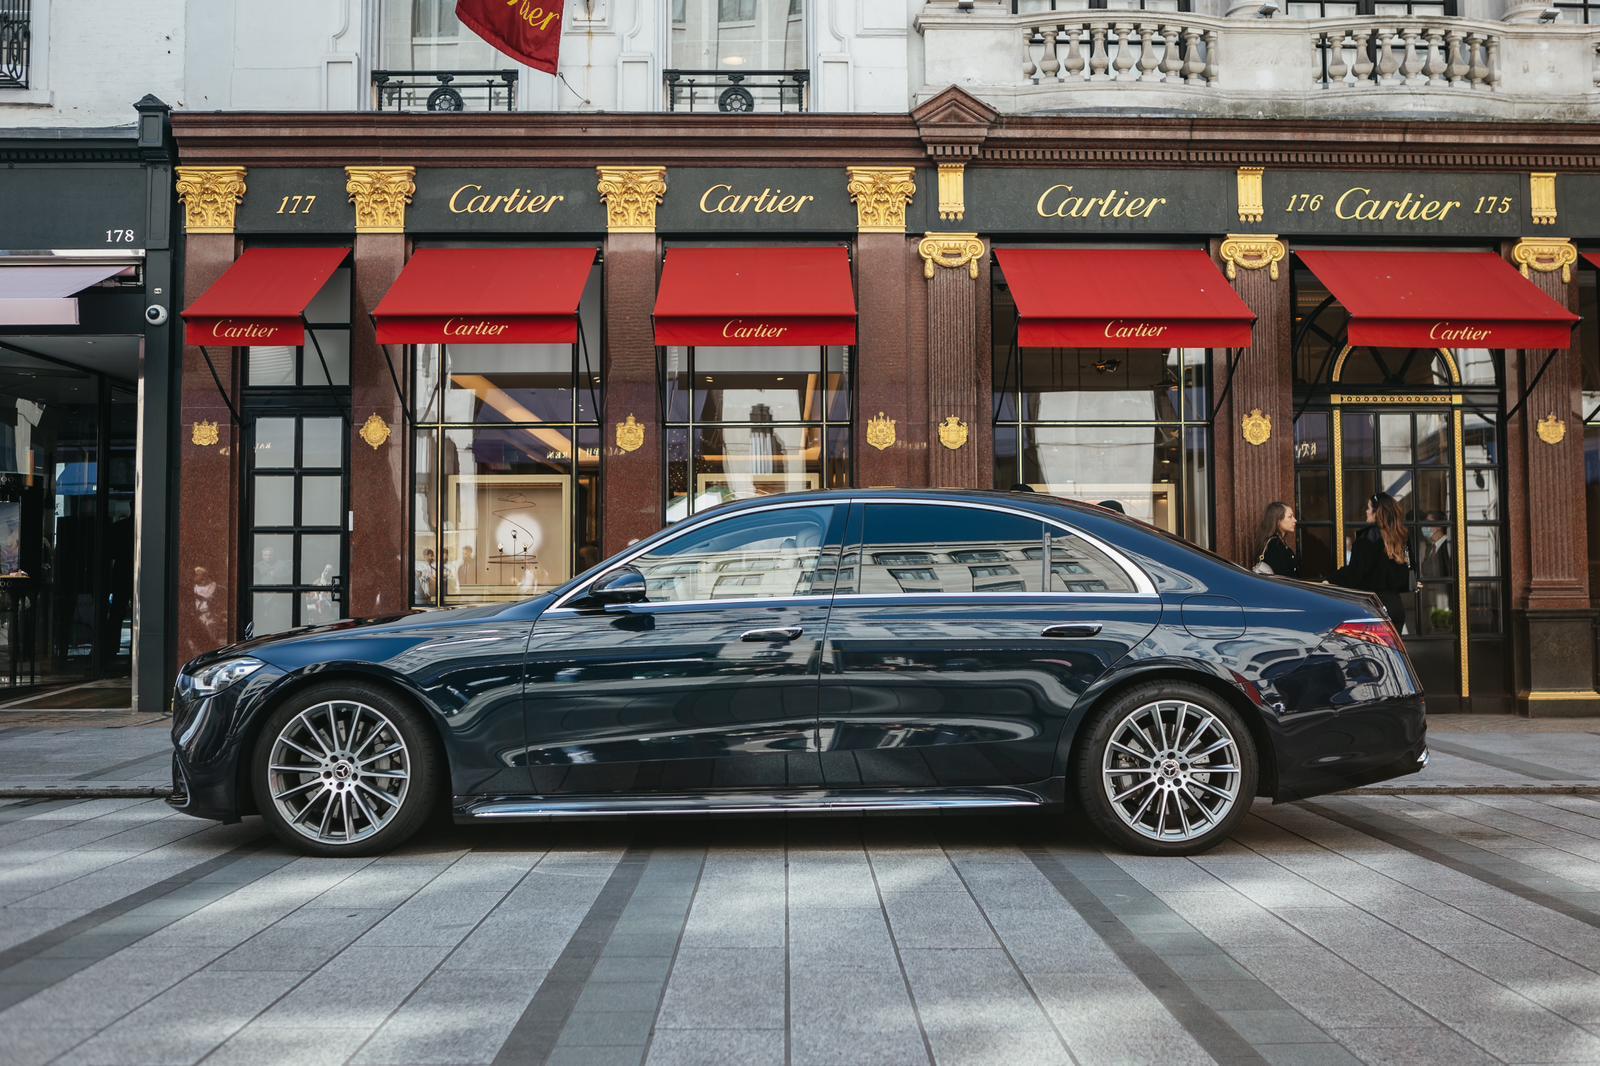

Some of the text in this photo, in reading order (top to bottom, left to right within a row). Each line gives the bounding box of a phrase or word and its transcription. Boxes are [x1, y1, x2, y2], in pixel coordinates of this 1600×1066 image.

[276, 195, 317, 215] 177
[448, 184, 565, 214] Cartier
[699, 184, 815, 214] Cartier
[1035, 184, 1166, 219] Cartier
[1285, 186, 1513, 221] 176 Cartier 175
[105, 229, 135, 243] 178
[212, 319, 279, 339] Cartier
[443, 318, 510, 337] Cartier
[722, 319, 788, 339] Cartier
[1104, 319, 1168, 338] Cartier
[1429, 321, 1492, 341] Cartier
